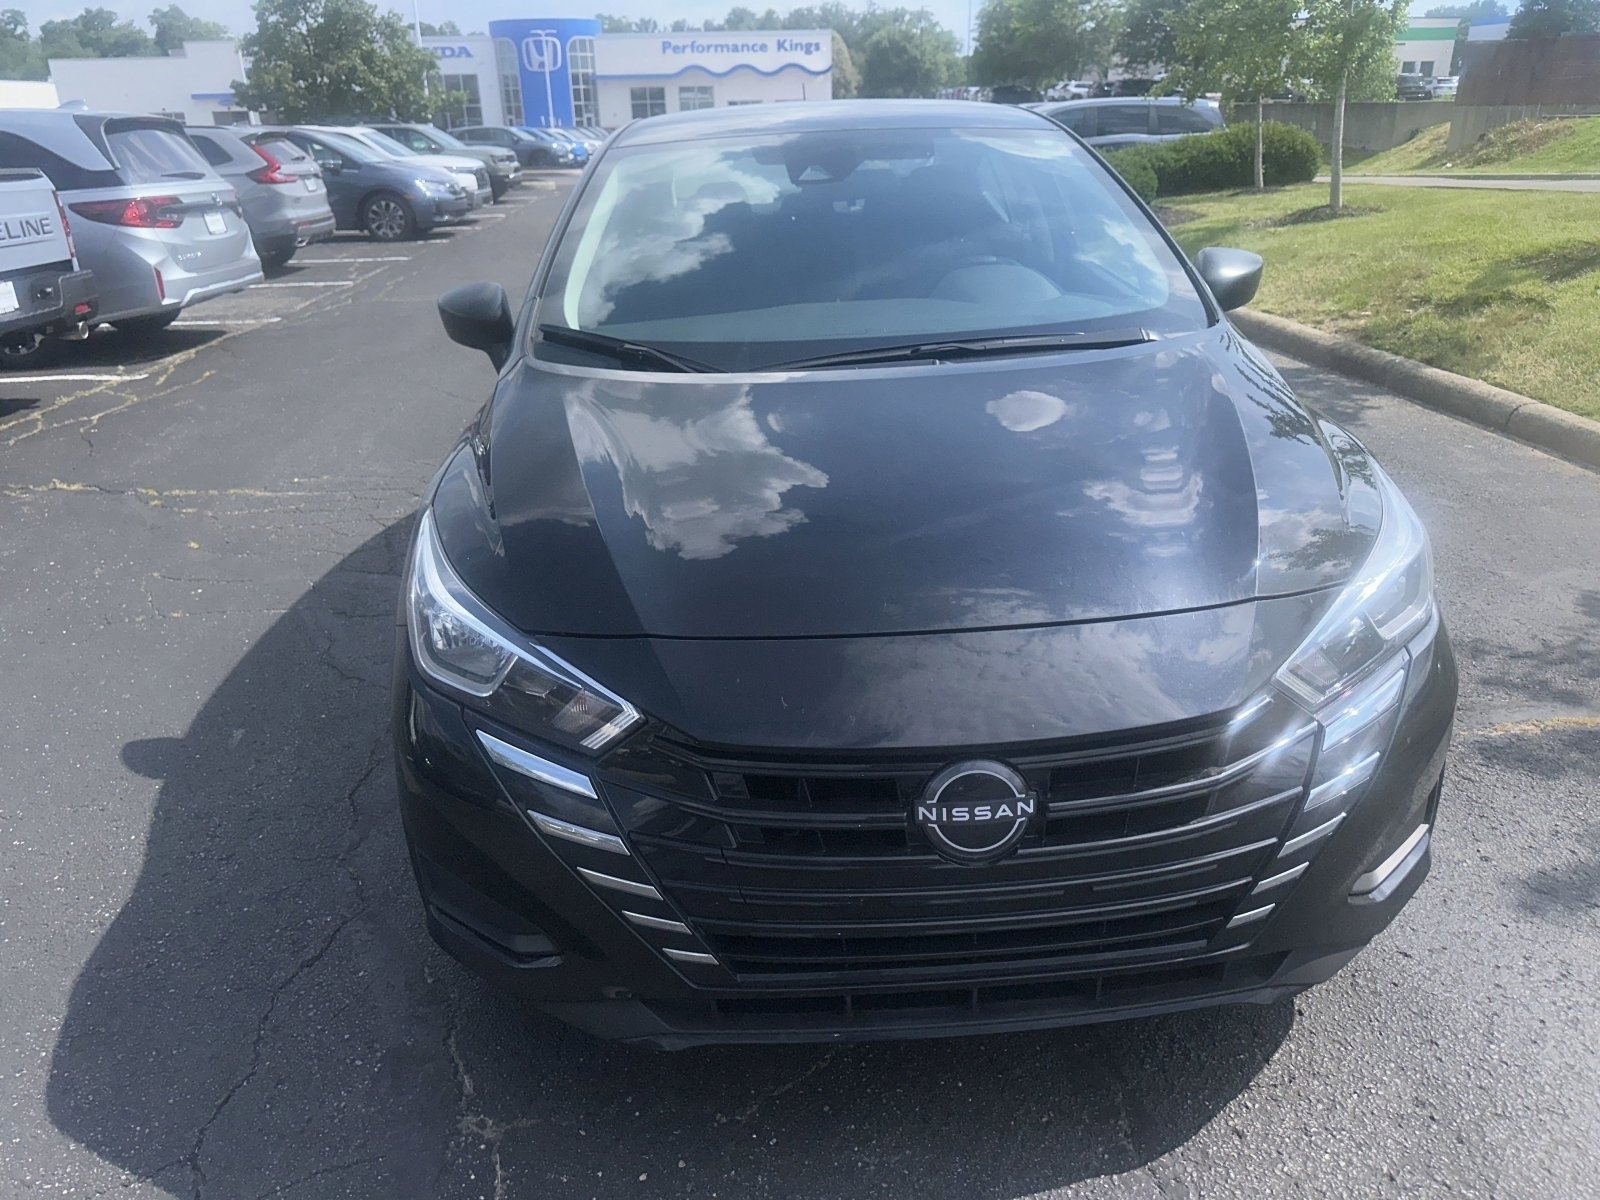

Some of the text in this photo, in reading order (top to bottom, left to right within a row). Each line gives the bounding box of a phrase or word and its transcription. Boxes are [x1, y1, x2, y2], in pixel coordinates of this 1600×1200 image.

[661, 39, 820, 55] Performance Kings
[918, 799, 1034, 822] NISSAN
